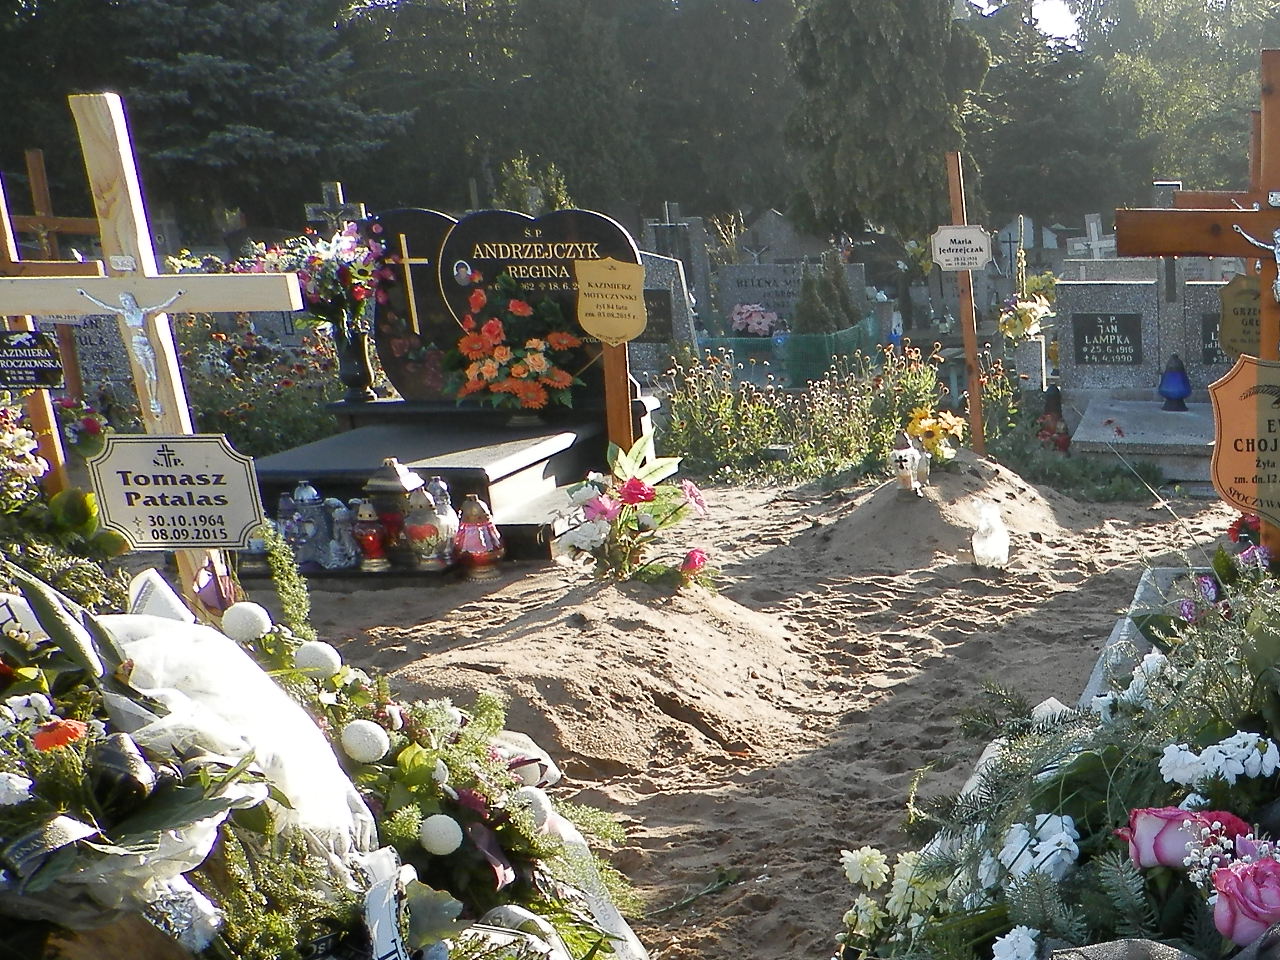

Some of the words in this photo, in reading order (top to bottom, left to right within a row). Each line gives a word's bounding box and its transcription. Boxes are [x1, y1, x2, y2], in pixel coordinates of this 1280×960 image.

[472, 243, 601, 259] ANDRZEJCZYK
[508, 265, 570, 278] REGINA
[587, 282, 632, 290] KAZIMIERZ
[1097, 324, 1118, 334] JAN
[1084, 335, 1130, 344] LAMPKA
[0, 359, 62, 369] ROCZKOWSKA
[116, 470, 227, 487] Tomasz
[1234, 475, 1248, 484] zm.
[124, 491, 229, 507] Patalas
[147, 514, 225, 527] 30.10.1964
[151, 528, 228, 540] 08.09.2015
